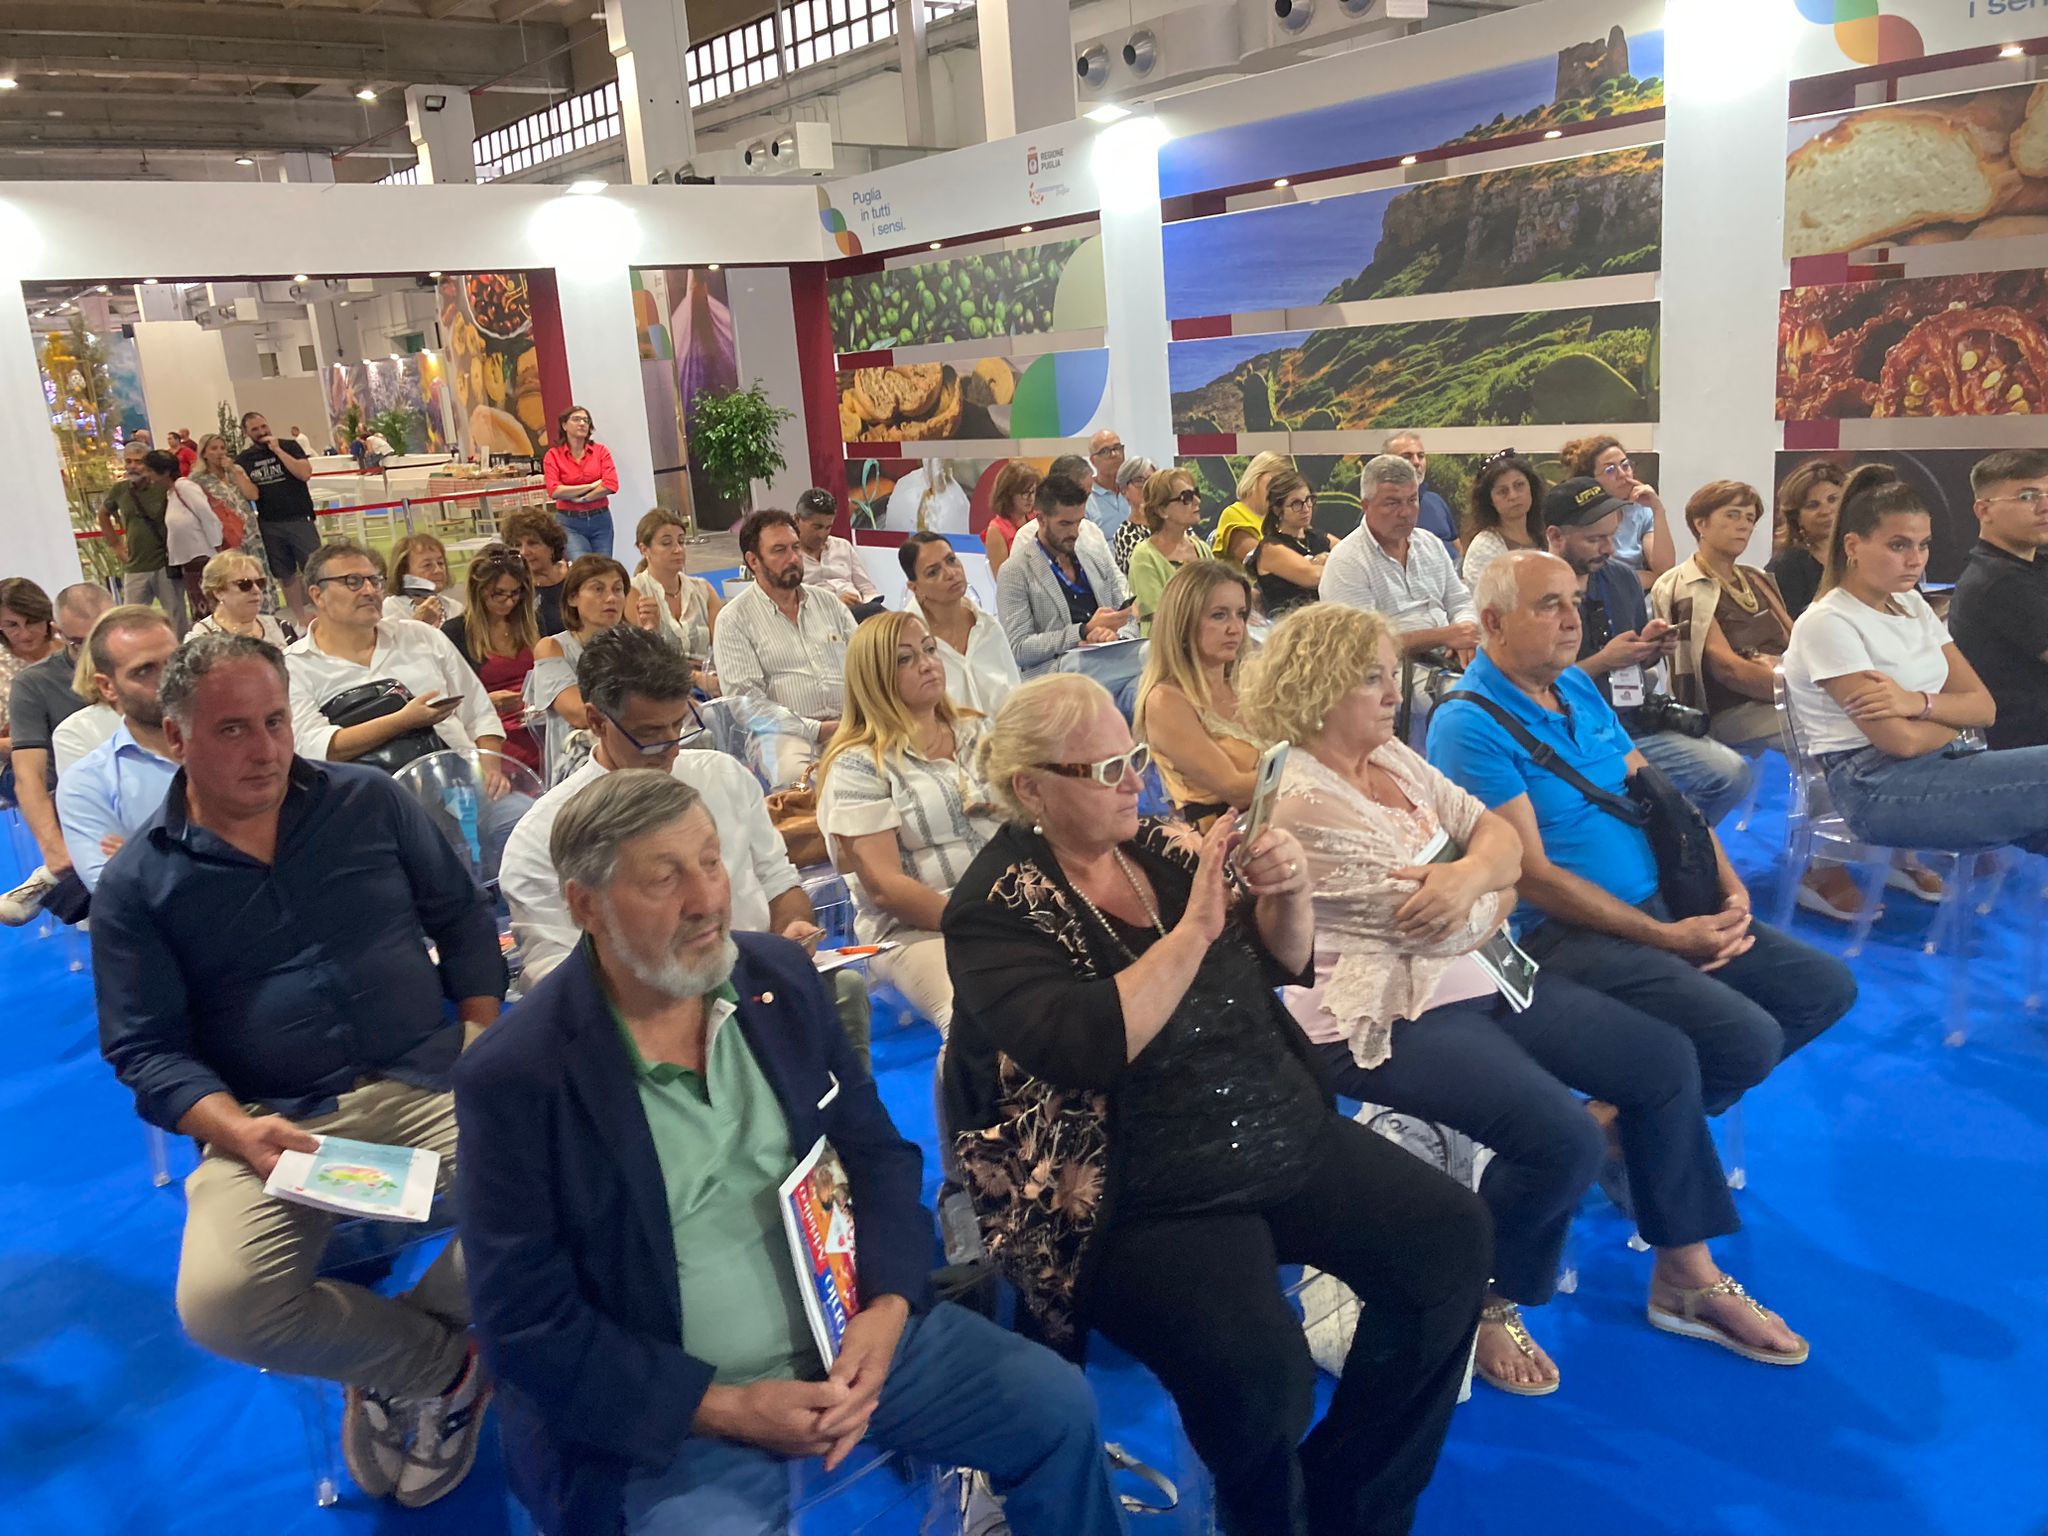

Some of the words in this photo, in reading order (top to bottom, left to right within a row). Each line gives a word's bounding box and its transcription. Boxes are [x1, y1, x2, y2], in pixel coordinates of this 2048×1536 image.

[1040, 148, 1064, 161] REGIONE
[1041, 159, 1061, 170] PUGLIA
[852, 187, 882, 206] Puglia
[861, 209, 870, 221] in
[872, 203, 891, 219] tutti
[877, 218, 907, 236] sensi.
[825, 1274, 847, 1345] onio
